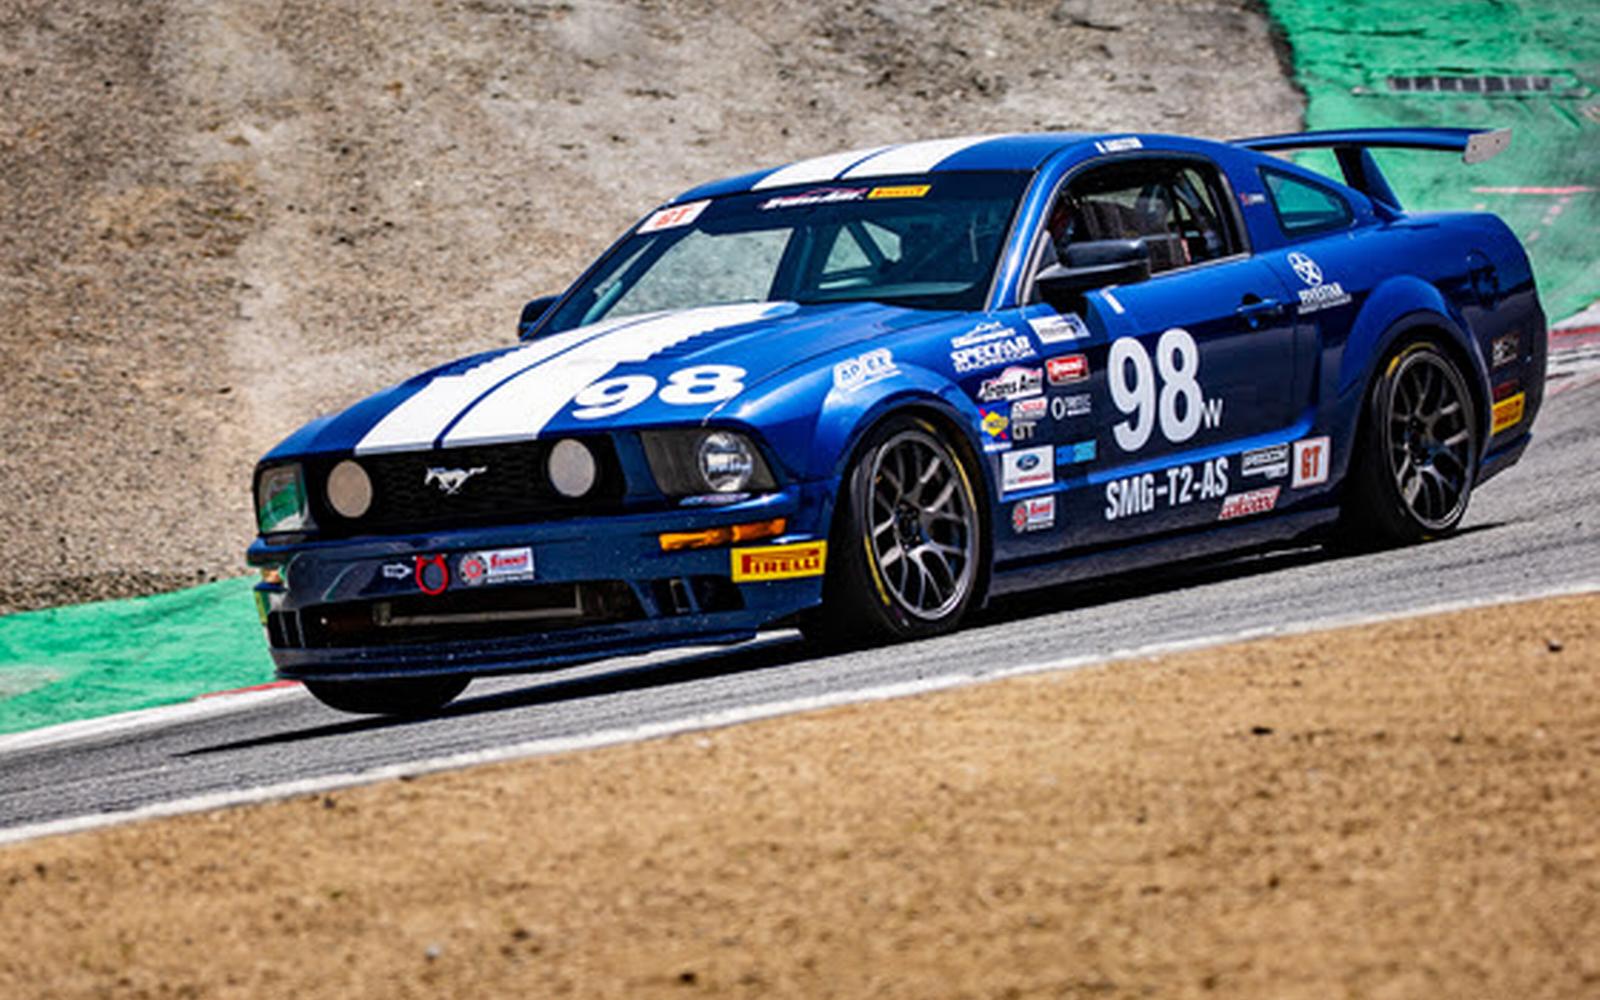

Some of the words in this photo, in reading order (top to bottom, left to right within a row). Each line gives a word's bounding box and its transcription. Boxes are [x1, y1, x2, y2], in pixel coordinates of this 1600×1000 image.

[572, 365, 747, 420] 98
[1107, 328, 1205, 452] 98
[1104, 457, 1229, 520] SMG-T2-AS
[1300, 446, 1321, 479] GT
[741, 549, 820, 574] PIRELLI
